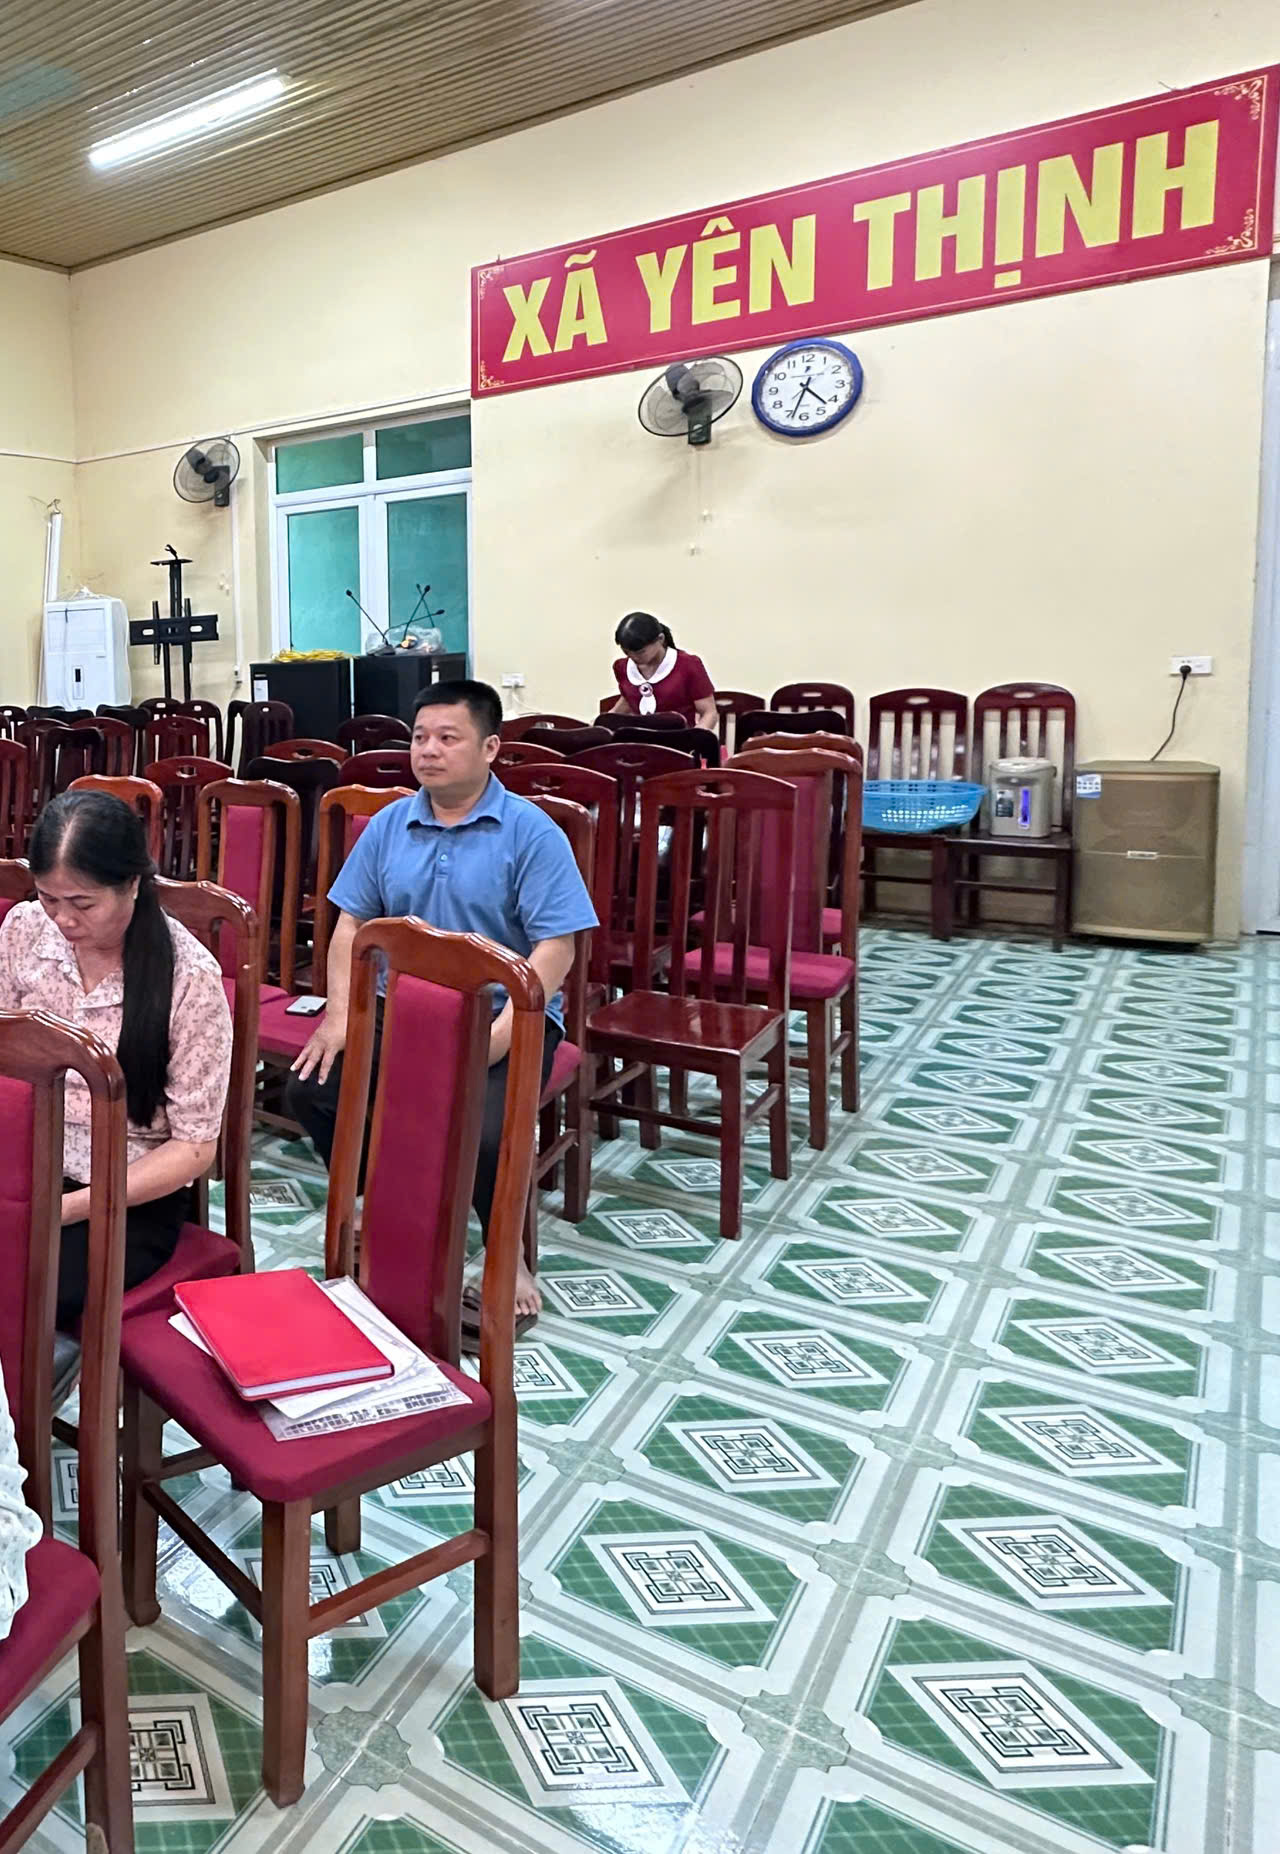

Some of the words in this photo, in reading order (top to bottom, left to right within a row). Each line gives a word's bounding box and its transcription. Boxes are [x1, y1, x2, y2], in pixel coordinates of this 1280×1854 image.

[502, 251, 608, 363] XÃ
[635, 217, 816, 334] YÊN
[853, 120, 1220, 289] THỊNH
[801, 353, 816, 363] 12
[787, 360, 796, 369] 11
[831, 365, 842, 375] 2
[774, 372, 787, 381] 10
[835, 380, 846, 389] 3
[768, 387, 779, 395] 9
[828, 394, 839, 403] 4
[772, 400, 783, 409] 8
[784, 409, 794, 418] 7
[816, 407, 826, 415] 5
[798, 412, 810, 421] 6
